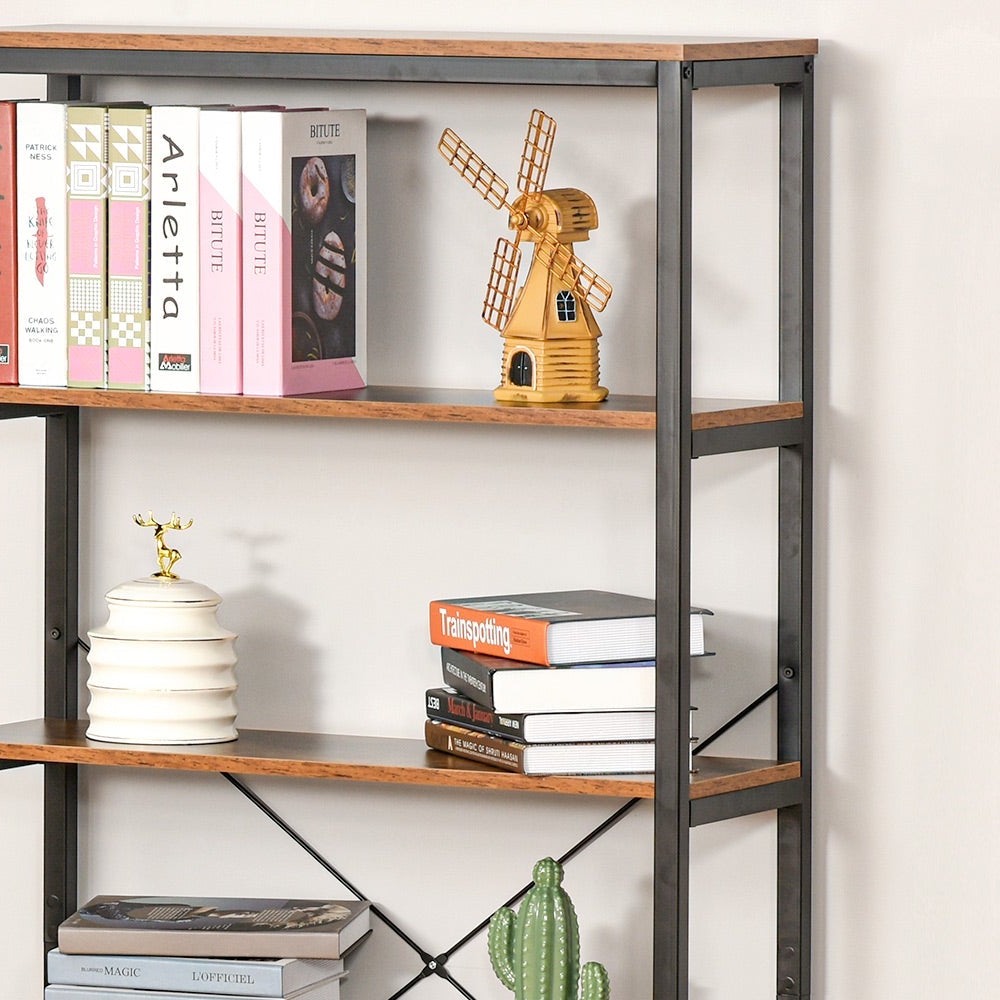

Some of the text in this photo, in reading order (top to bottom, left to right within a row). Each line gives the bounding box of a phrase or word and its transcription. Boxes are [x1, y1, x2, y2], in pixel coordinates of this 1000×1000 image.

[310, 123, 341, 138] BITUTE
[25, 143, 57, 151] PATRICK
[30, 153, 52, 161] NESS
[162, 134, 187, 319] Arletta
[211, 210, 223, 273] BITUTE
[254, 212, 266, 275] BITUTE
[28, 317, 55, 325] CHAOS
[104, 966, 141, 977] MAGIC
[192, 972, 255, 984] L'OFFICIEL
